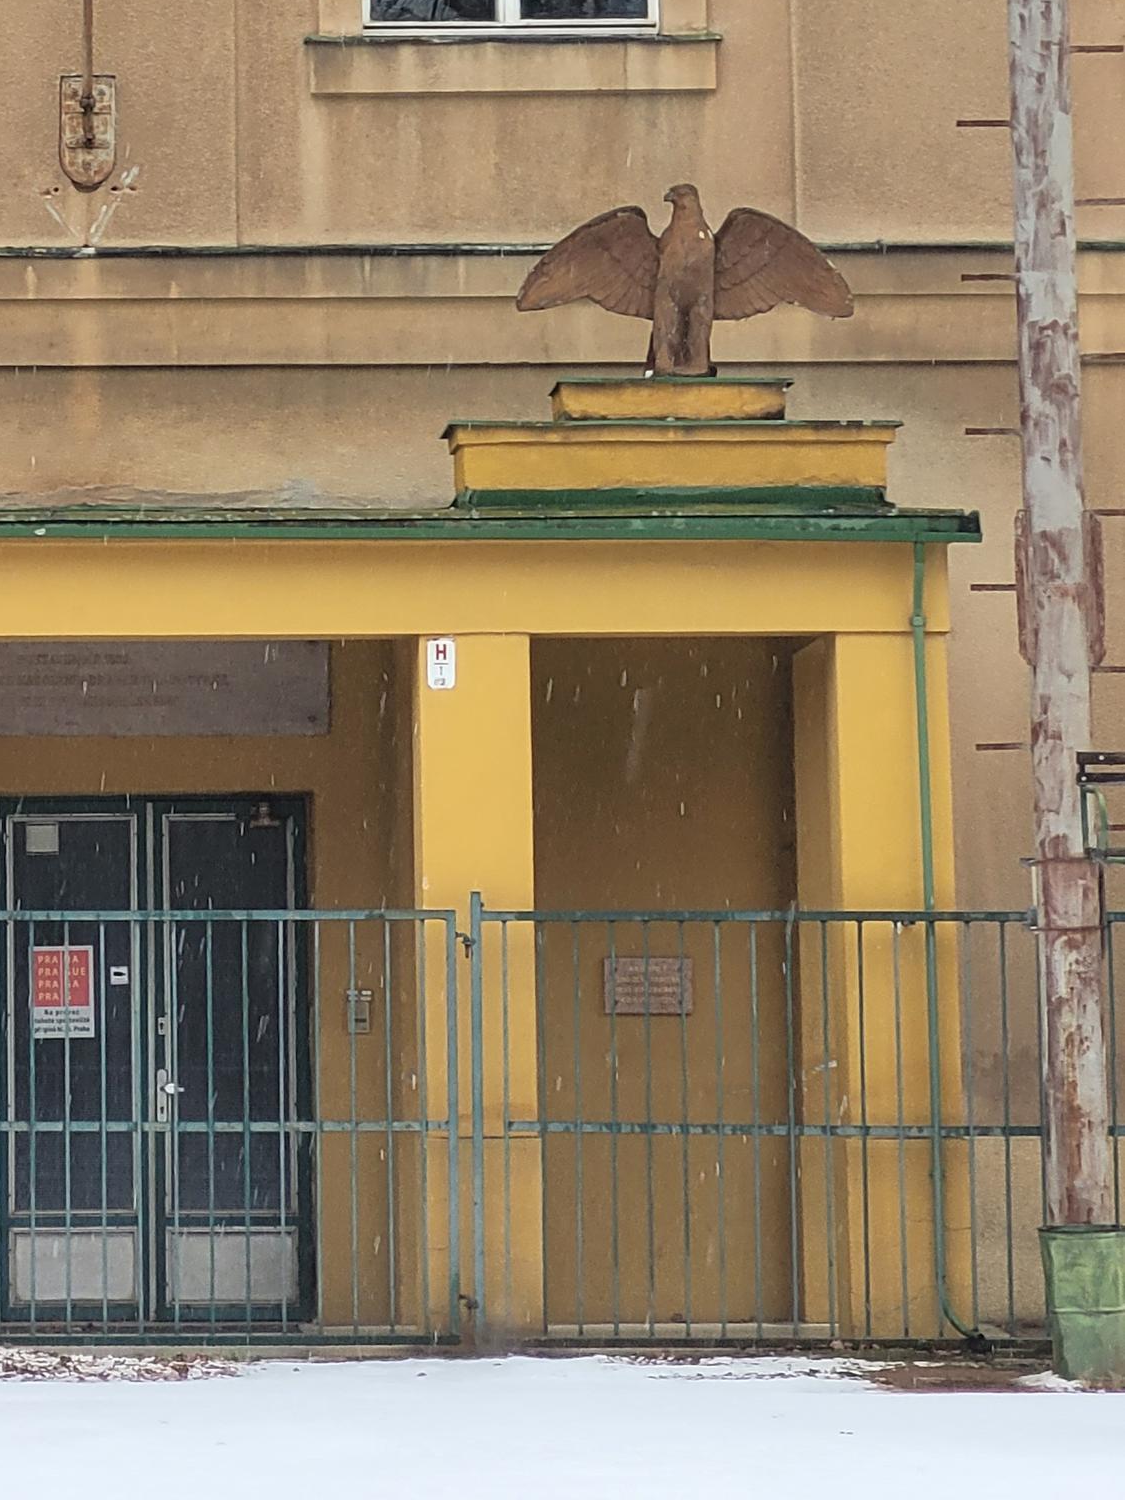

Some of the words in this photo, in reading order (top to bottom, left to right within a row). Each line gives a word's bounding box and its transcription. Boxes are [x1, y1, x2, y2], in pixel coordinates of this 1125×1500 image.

[435, 643, 447, 661] H
[37, 967, 86, 976] PRAUE
[38, 980, 80, 988] PRAA
